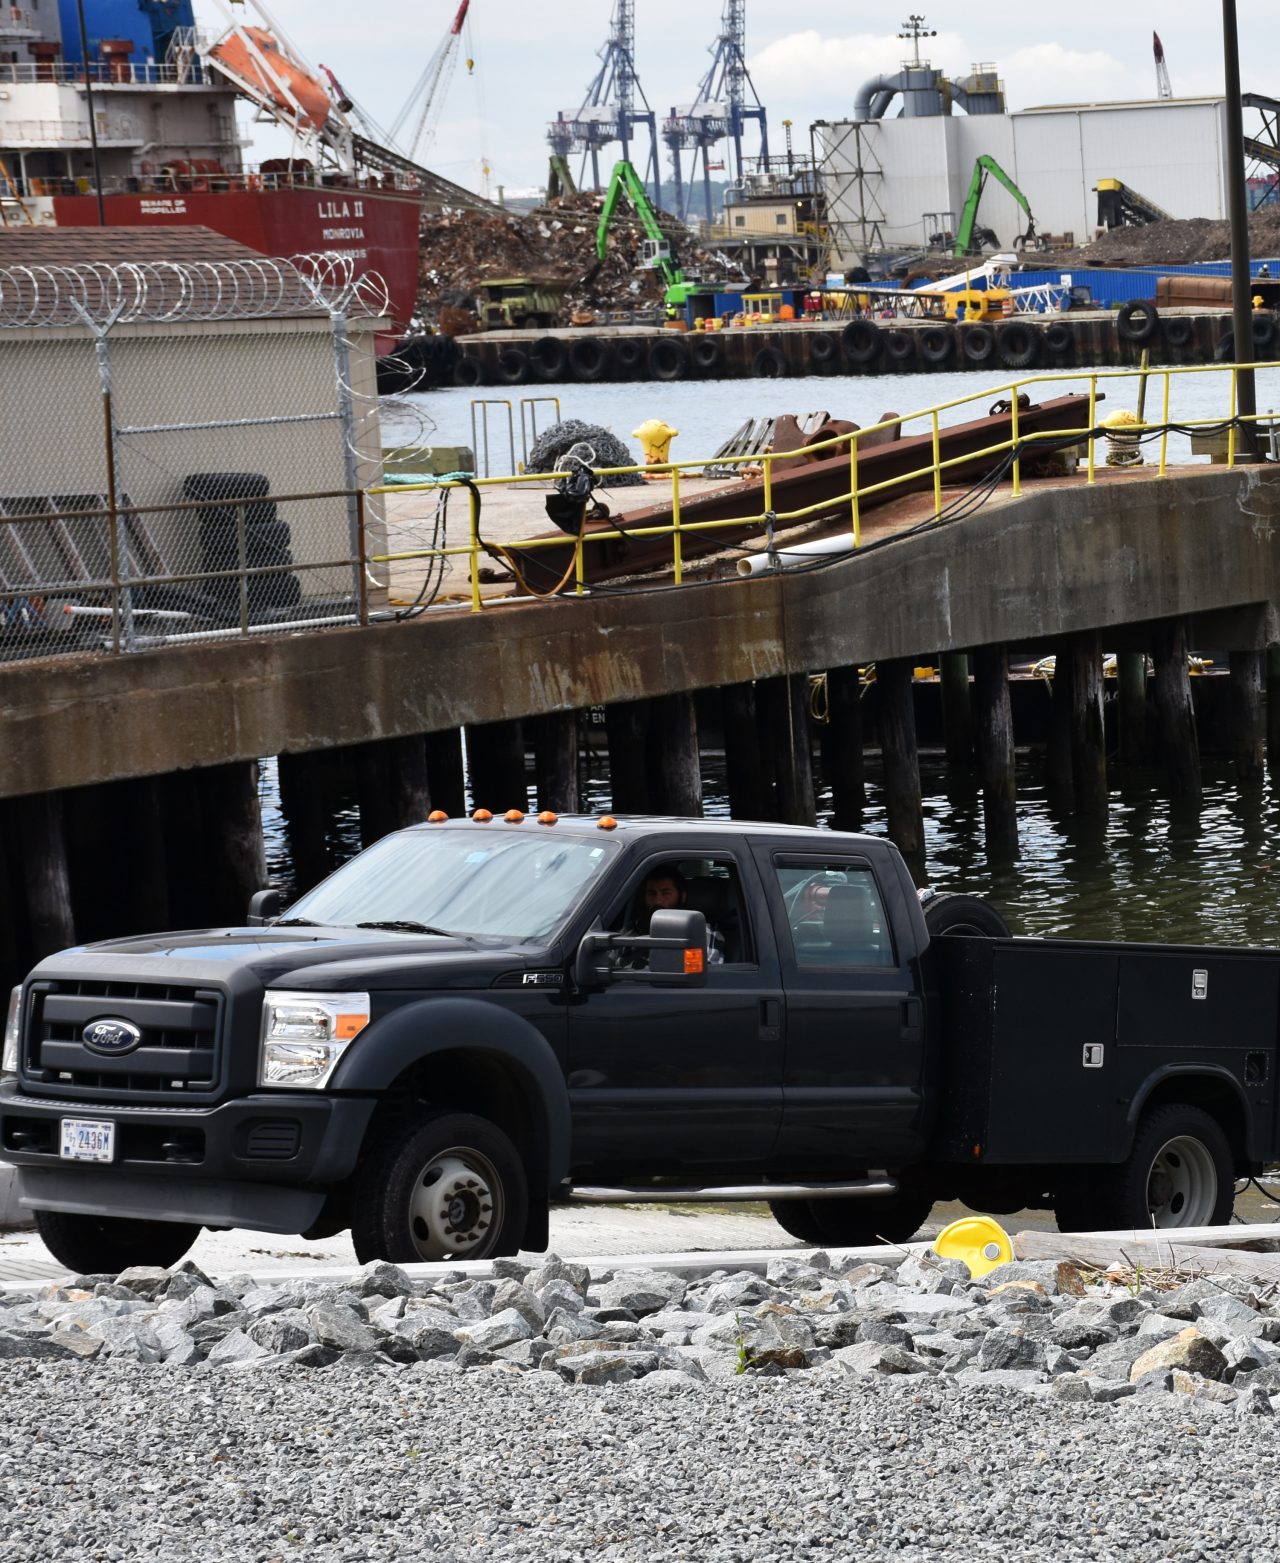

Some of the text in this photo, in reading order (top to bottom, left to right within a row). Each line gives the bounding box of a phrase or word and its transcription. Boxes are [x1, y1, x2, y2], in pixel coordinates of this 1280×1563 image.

[318, 201, 364, 218] LILA II
[323, 228, 365, 239] MONROVIA
[91, 1023, 124, 1045] Ford
